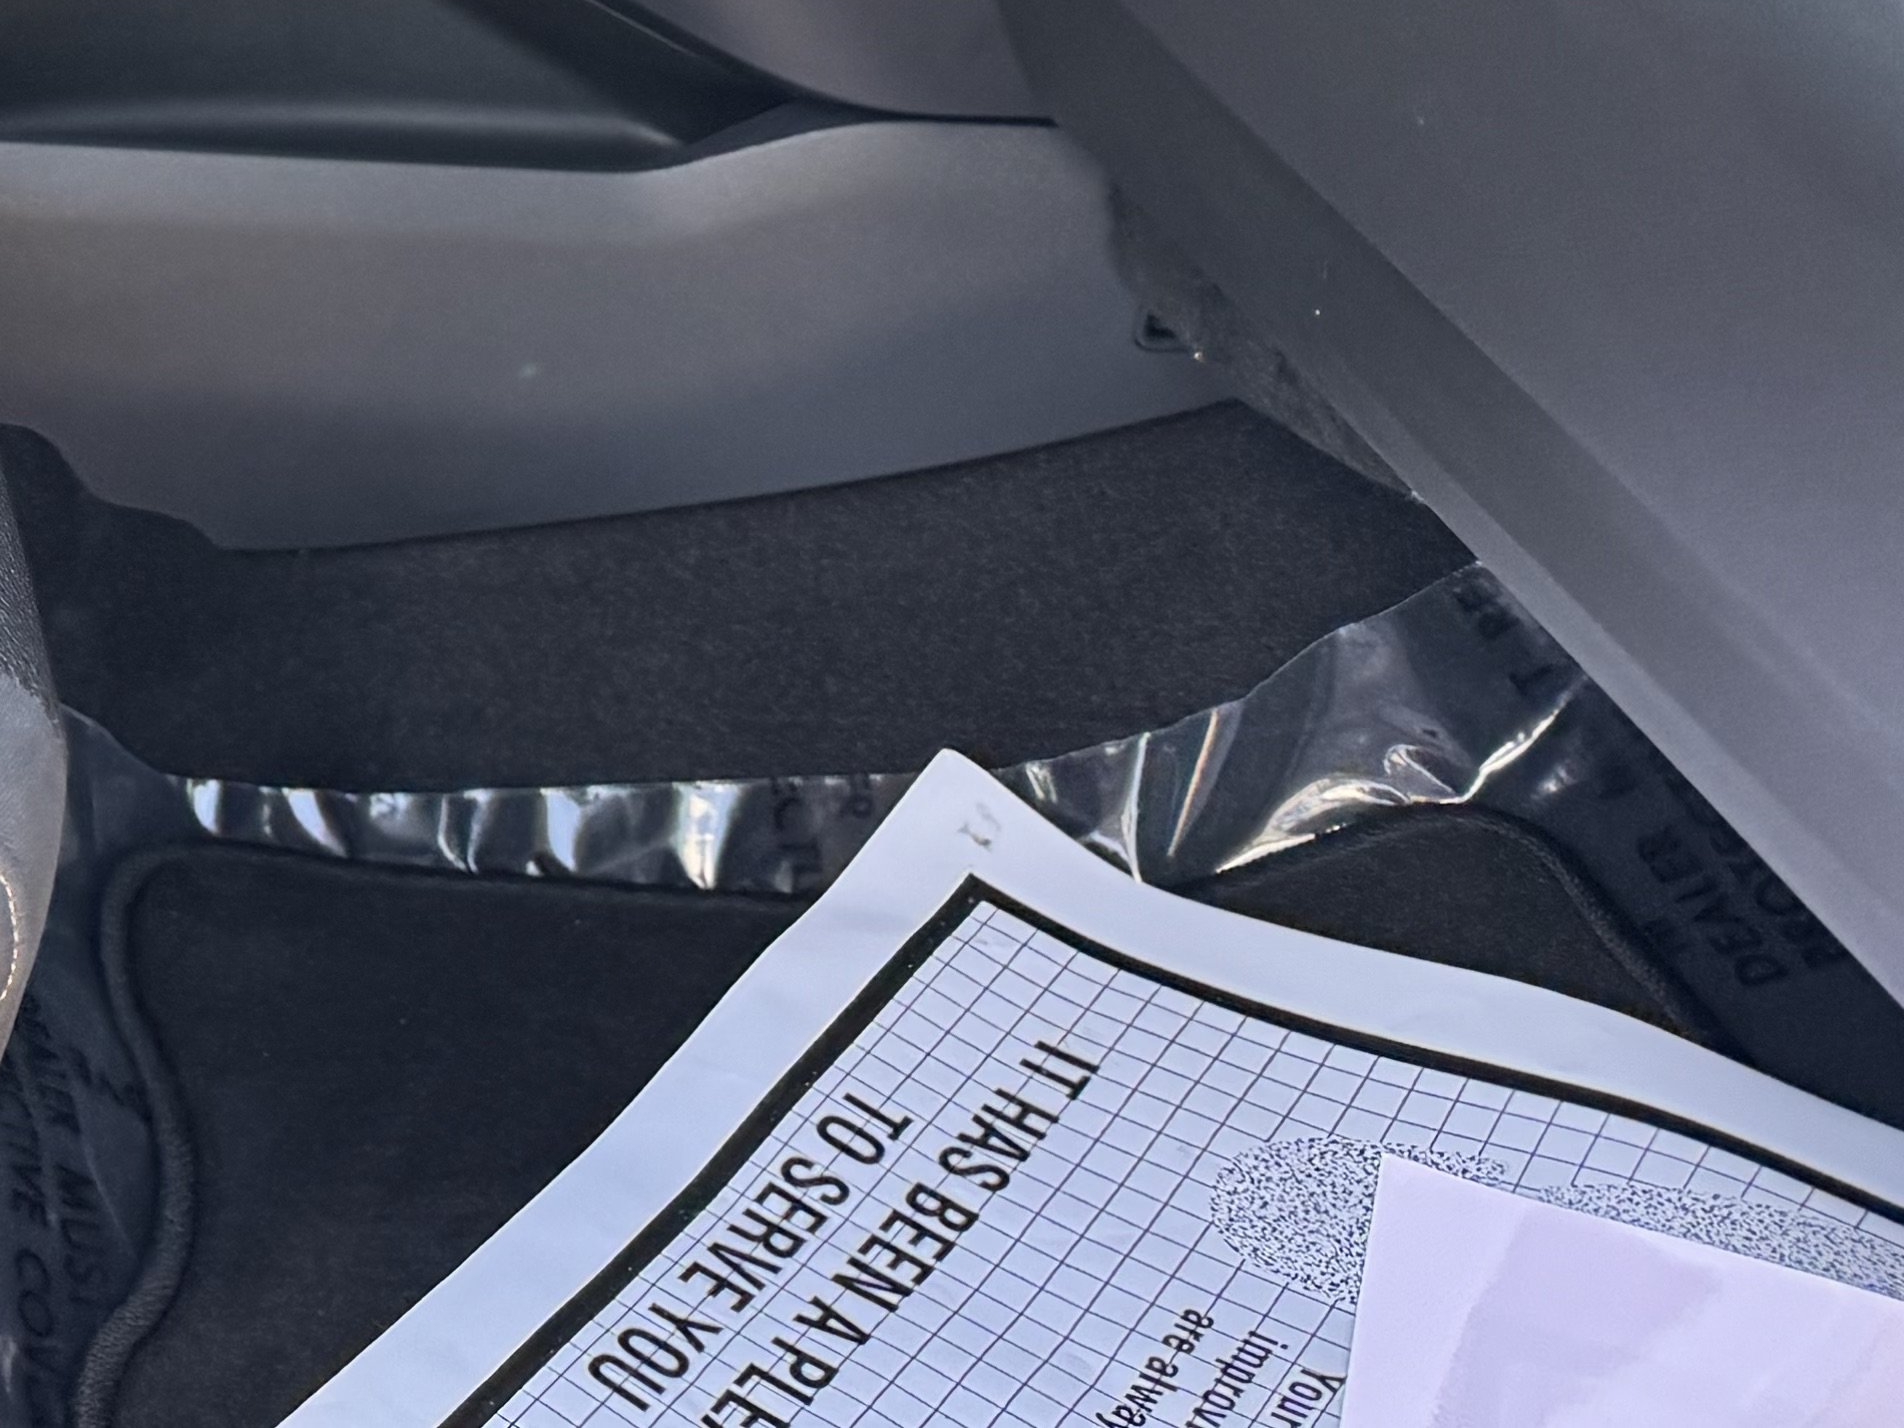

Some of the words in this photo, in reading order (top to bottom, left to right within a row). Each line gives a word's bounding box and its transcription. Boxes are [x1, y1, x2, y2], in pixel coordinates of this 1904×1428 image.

[1019, 1040, 1100, 1101] IT
[816, 1092, 915, 1166] TO
[938, 1088, 1060, 1193] HAS
[677, 1156, 851, 1314] SERVE
[831, 1182, 980, 1313] BEEN
[587, 1301, 725, 1413] YOU
[792, 1295, 872, 1345] A
[1161, 1308, 1215, 1355] are
[700, 1336, 840, 1428] PLE
